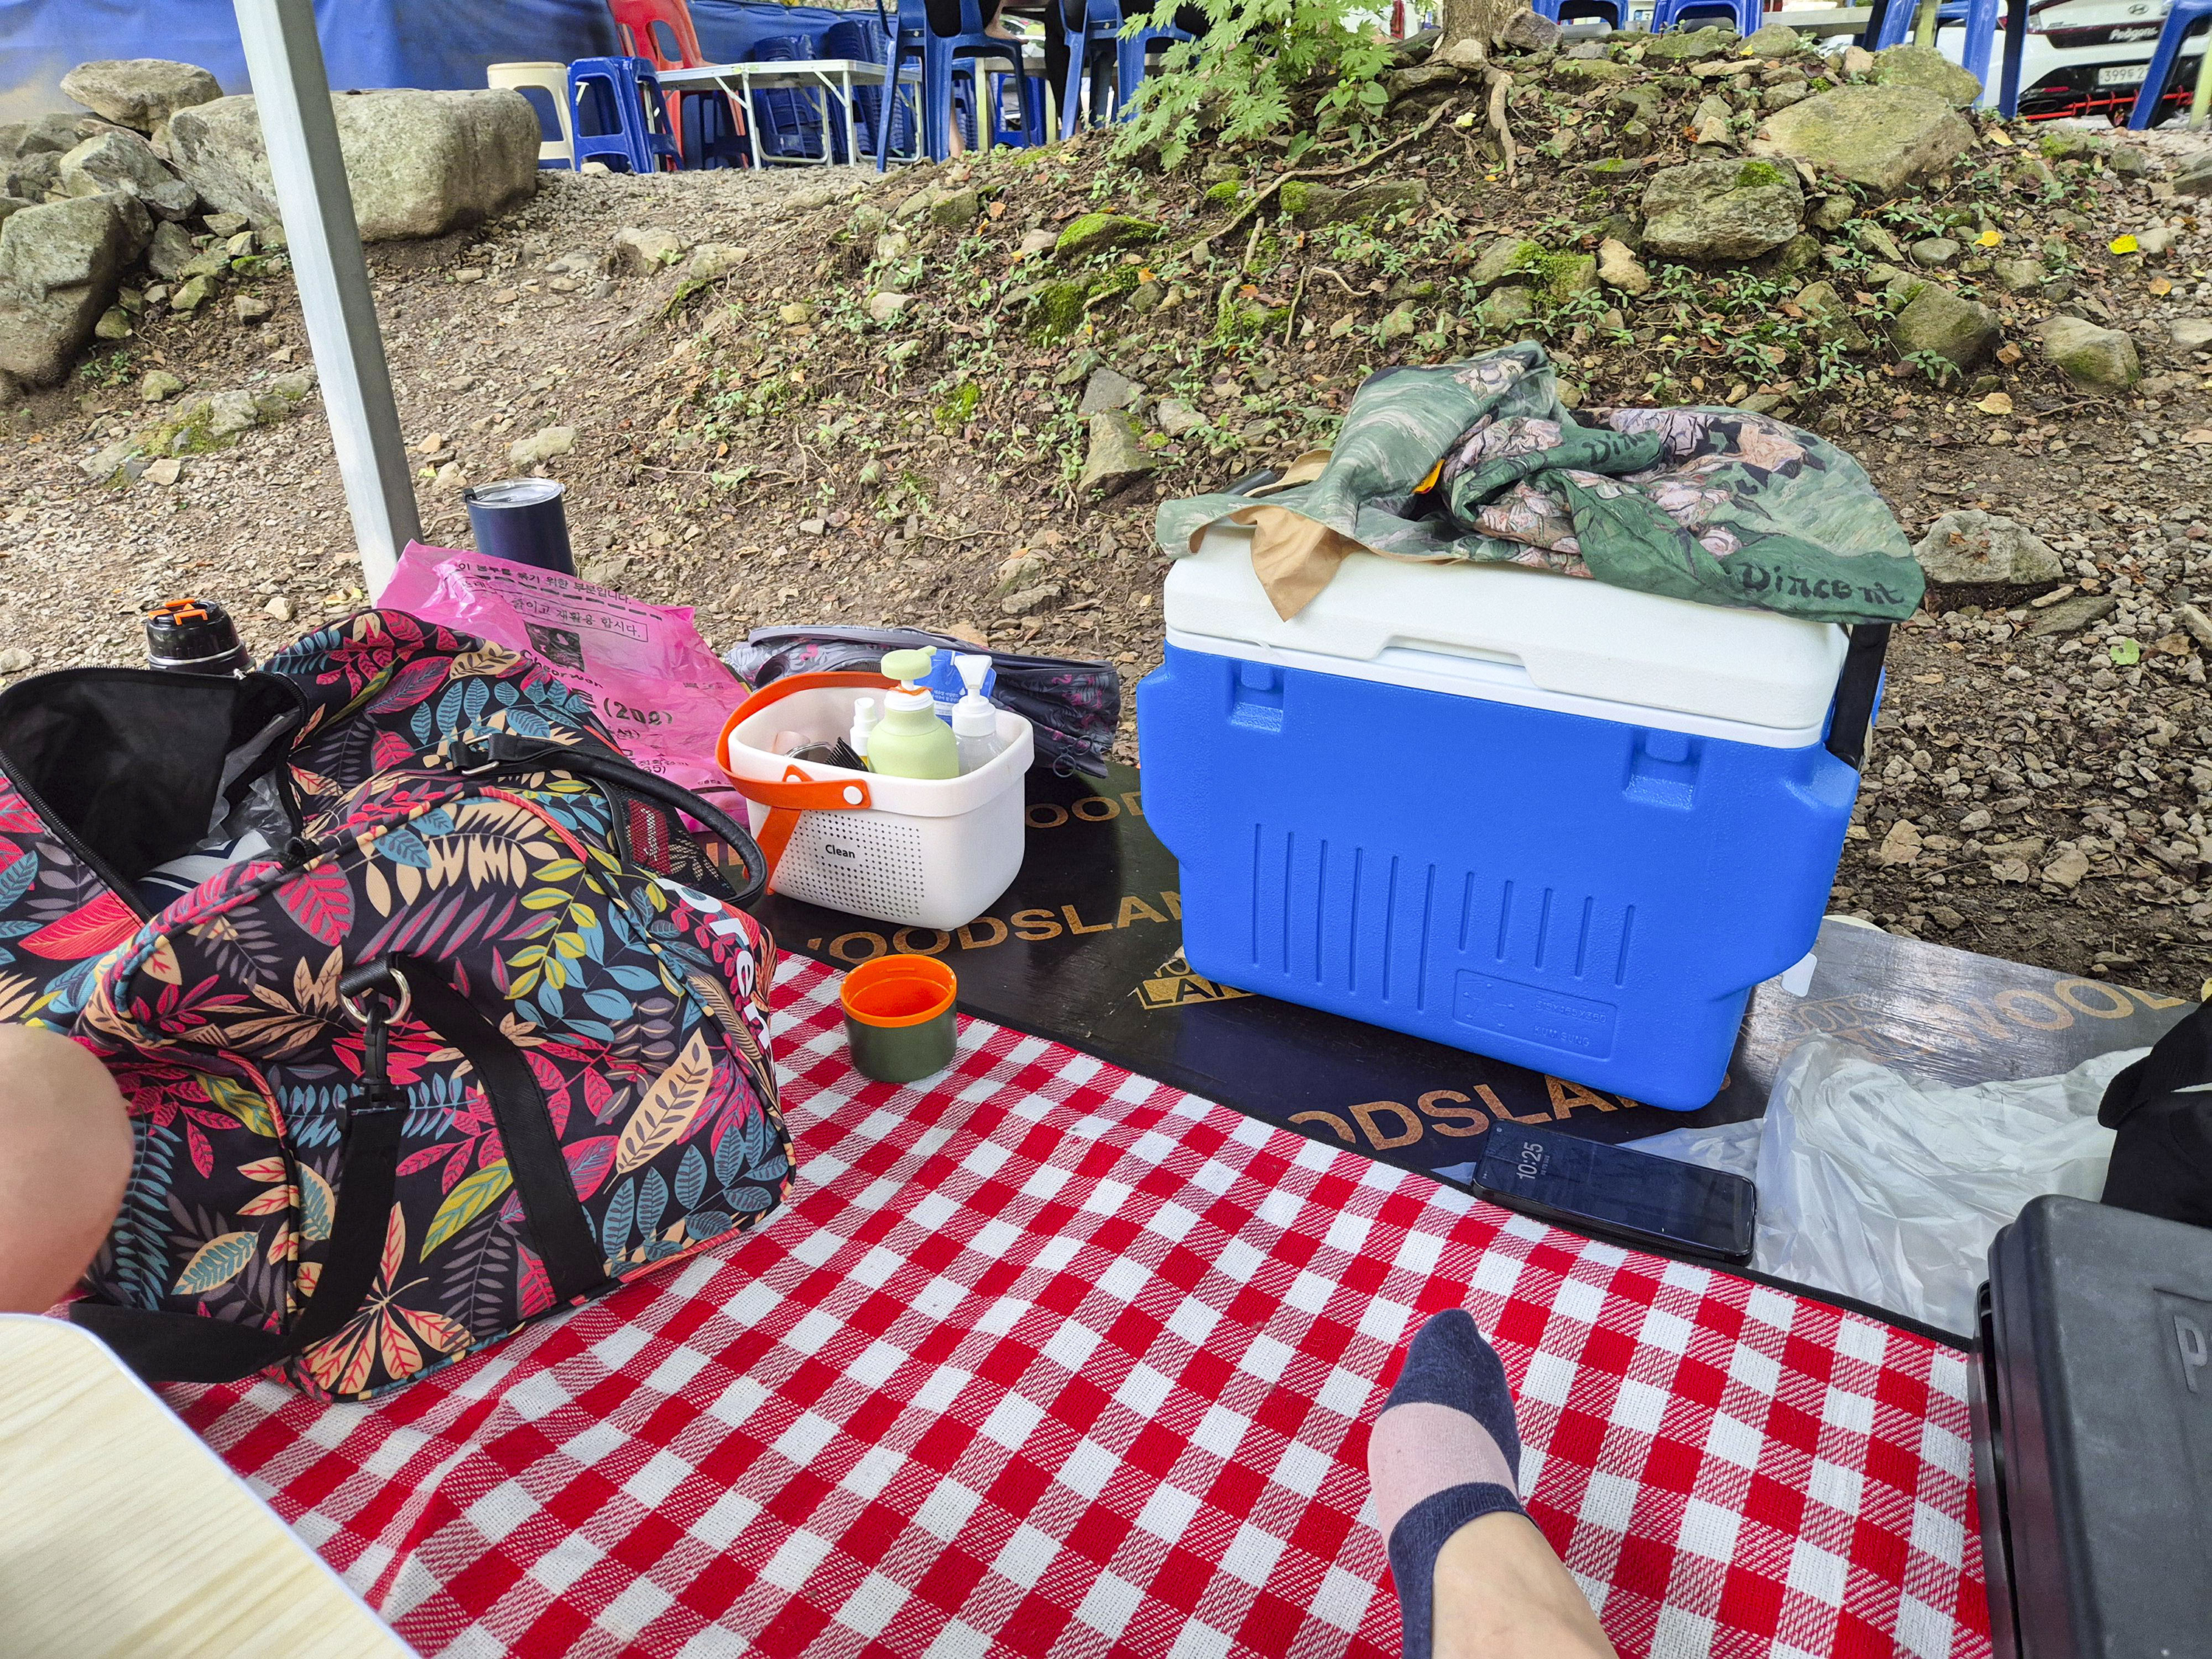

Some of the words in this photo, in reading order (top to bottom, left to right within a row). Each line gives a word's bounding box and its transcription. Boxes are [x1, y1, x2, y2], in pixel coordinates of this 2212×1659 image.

[546, 576, 568, 589] 위한
[573, 581, 632, 605] 부분입니다.
[555, 608, 596, 626] 재활용
[601, 616, 641, 638] 합시다.
[825, 844, 855, 858] Clean
[1516, 1141, 1544, 1180] 10:25
